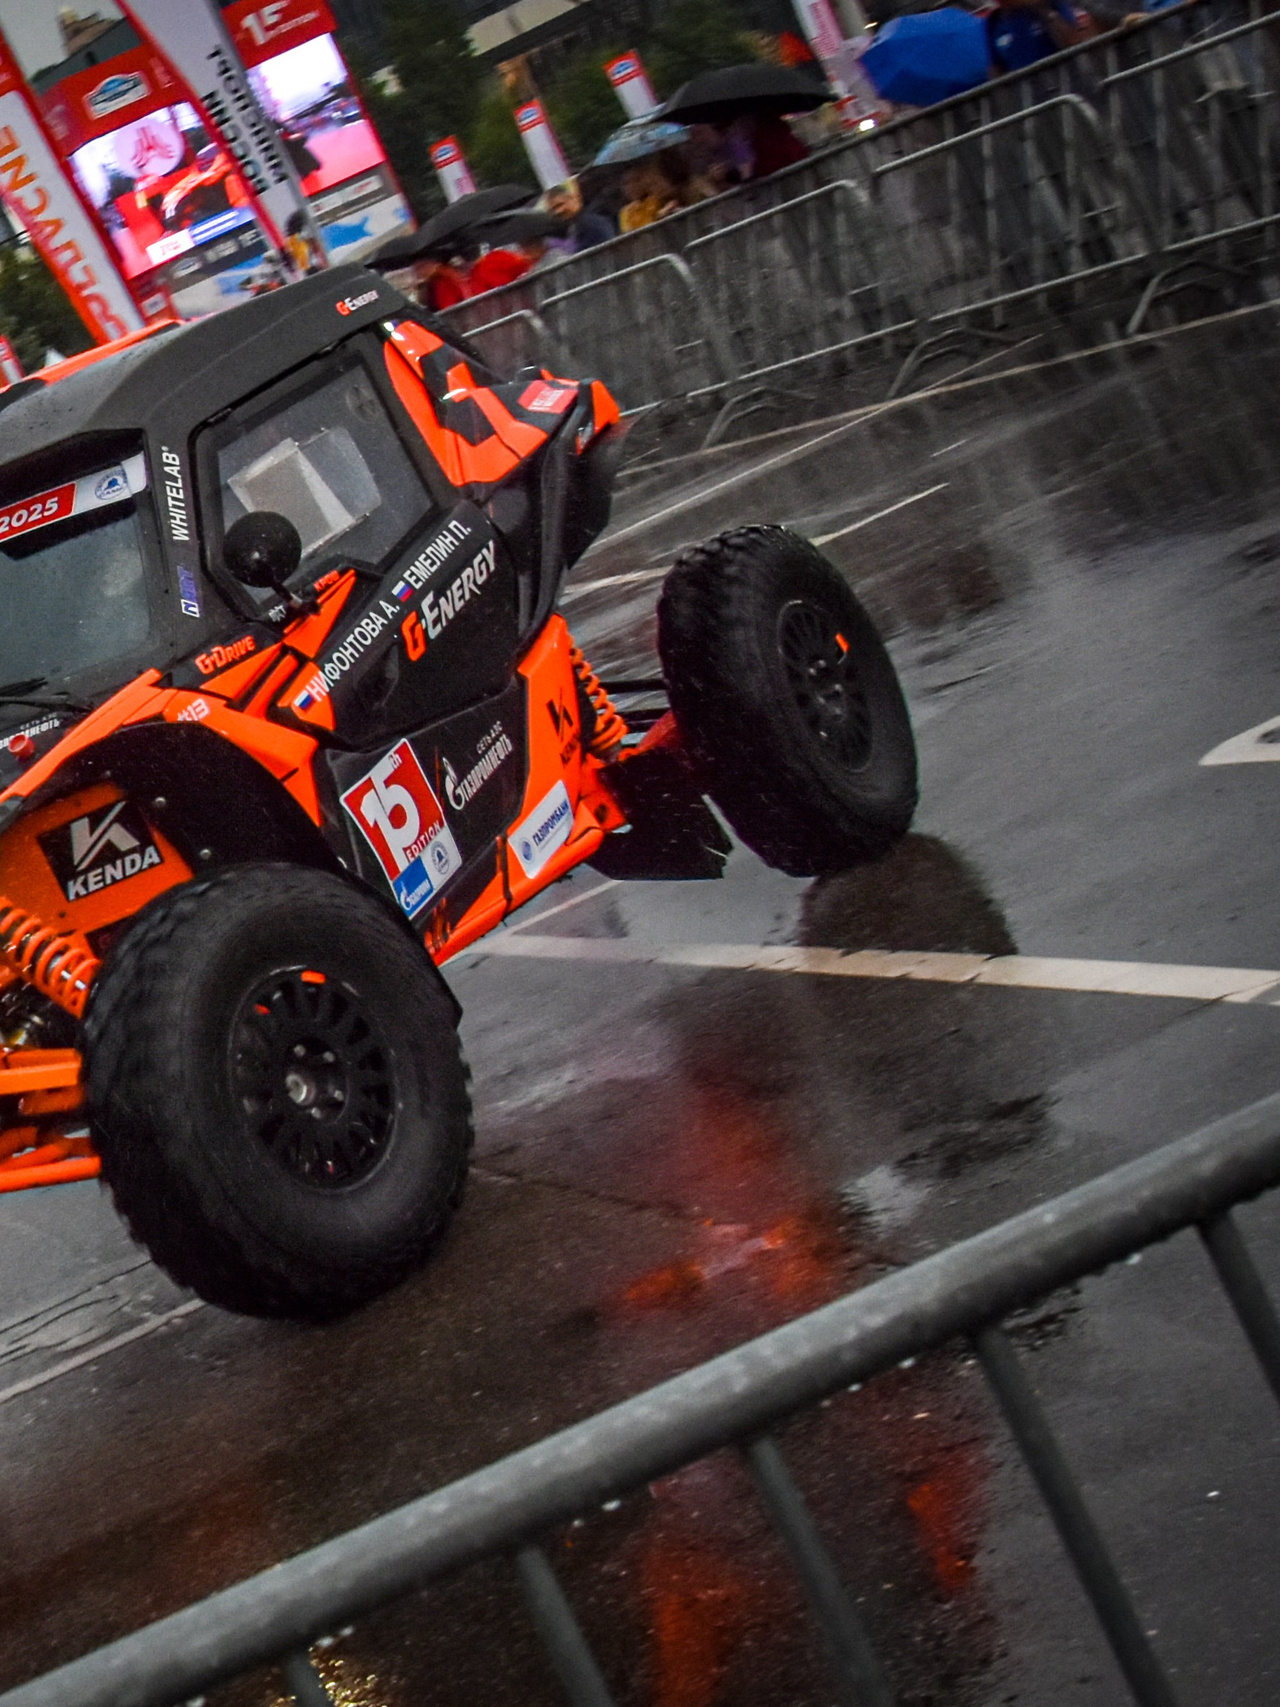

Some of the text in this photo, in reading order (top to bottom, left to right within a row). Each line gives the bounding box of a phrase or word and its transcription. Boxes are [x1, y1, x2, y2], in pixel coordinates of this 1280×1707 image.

[403, 530, 459, 589] ЕМЕЛИН
[305, 612, 388, 701] НИФОНТОВА
[406, 820, 442, 862] EDITION
[533, 798, 569, 846] ГАЗПРОМБАНК
[67, 845, 162, 901] KENDA
